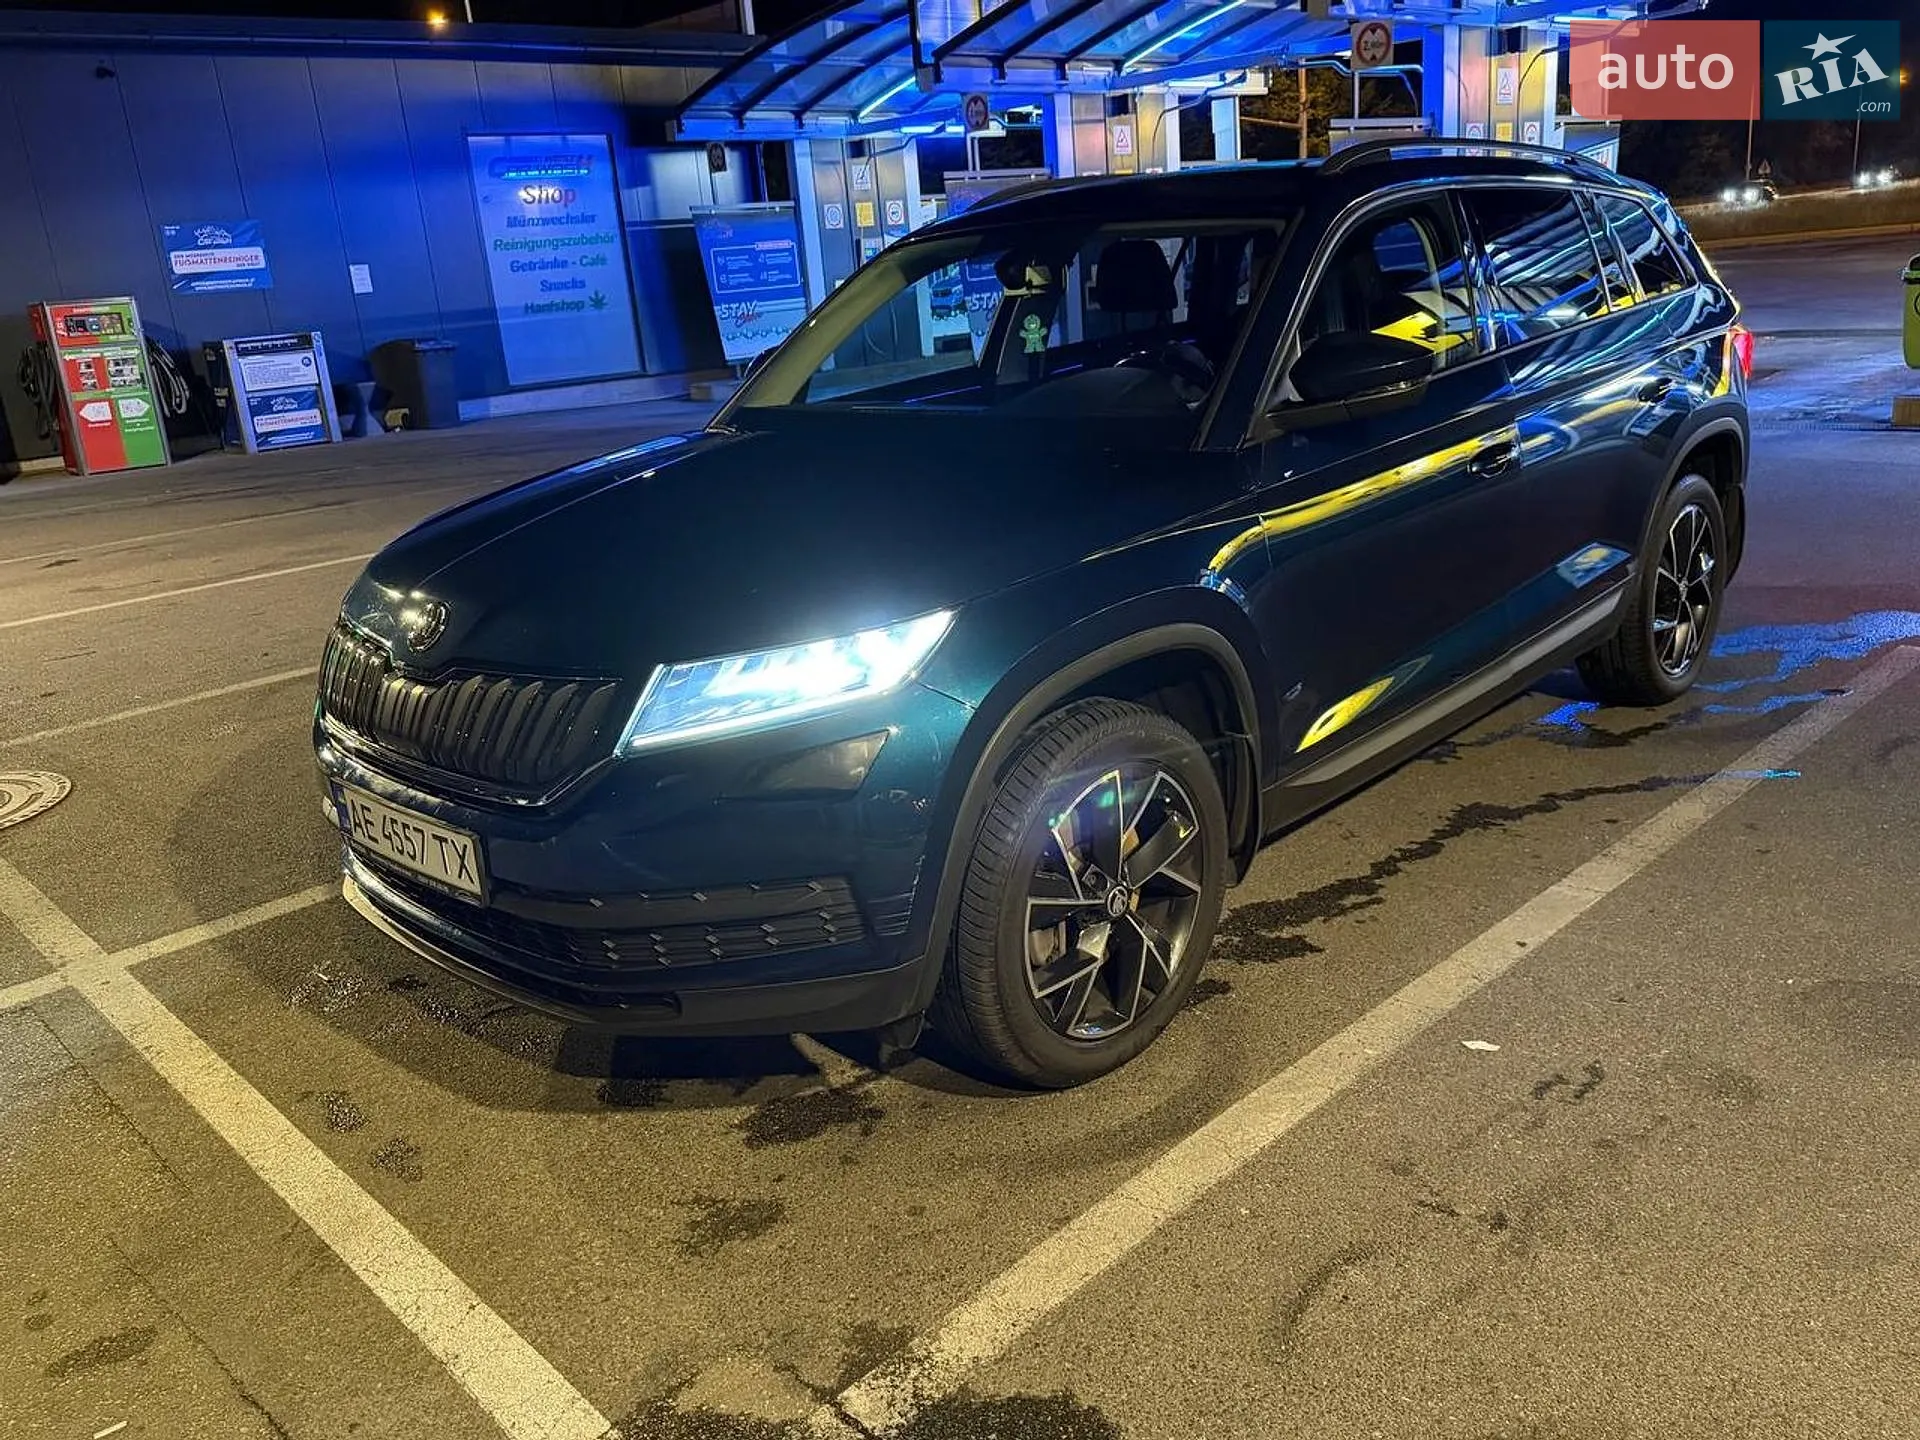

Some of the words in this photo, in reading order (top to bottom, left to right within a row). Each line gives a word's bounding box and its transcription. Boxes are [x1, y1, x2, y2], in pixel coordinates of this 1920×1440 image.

[521, 184, 576, 207] Shop
[506, 212, 597, 228] Münzwechsler
[493, 232, 615, 252] Reinigungszubehör
[510, 256, 569, 273] Getränke
[579, 254, 607, 268] Café
[539, 277, 587, 292] Snacks
[524, 299, 584, 315] Hanfshop
[719, 300, 757, 320] STAY
[350, 799, 379, 845] AE
[382, 814, 426, 865] 4557
[431, 833, 475, 884] TX
